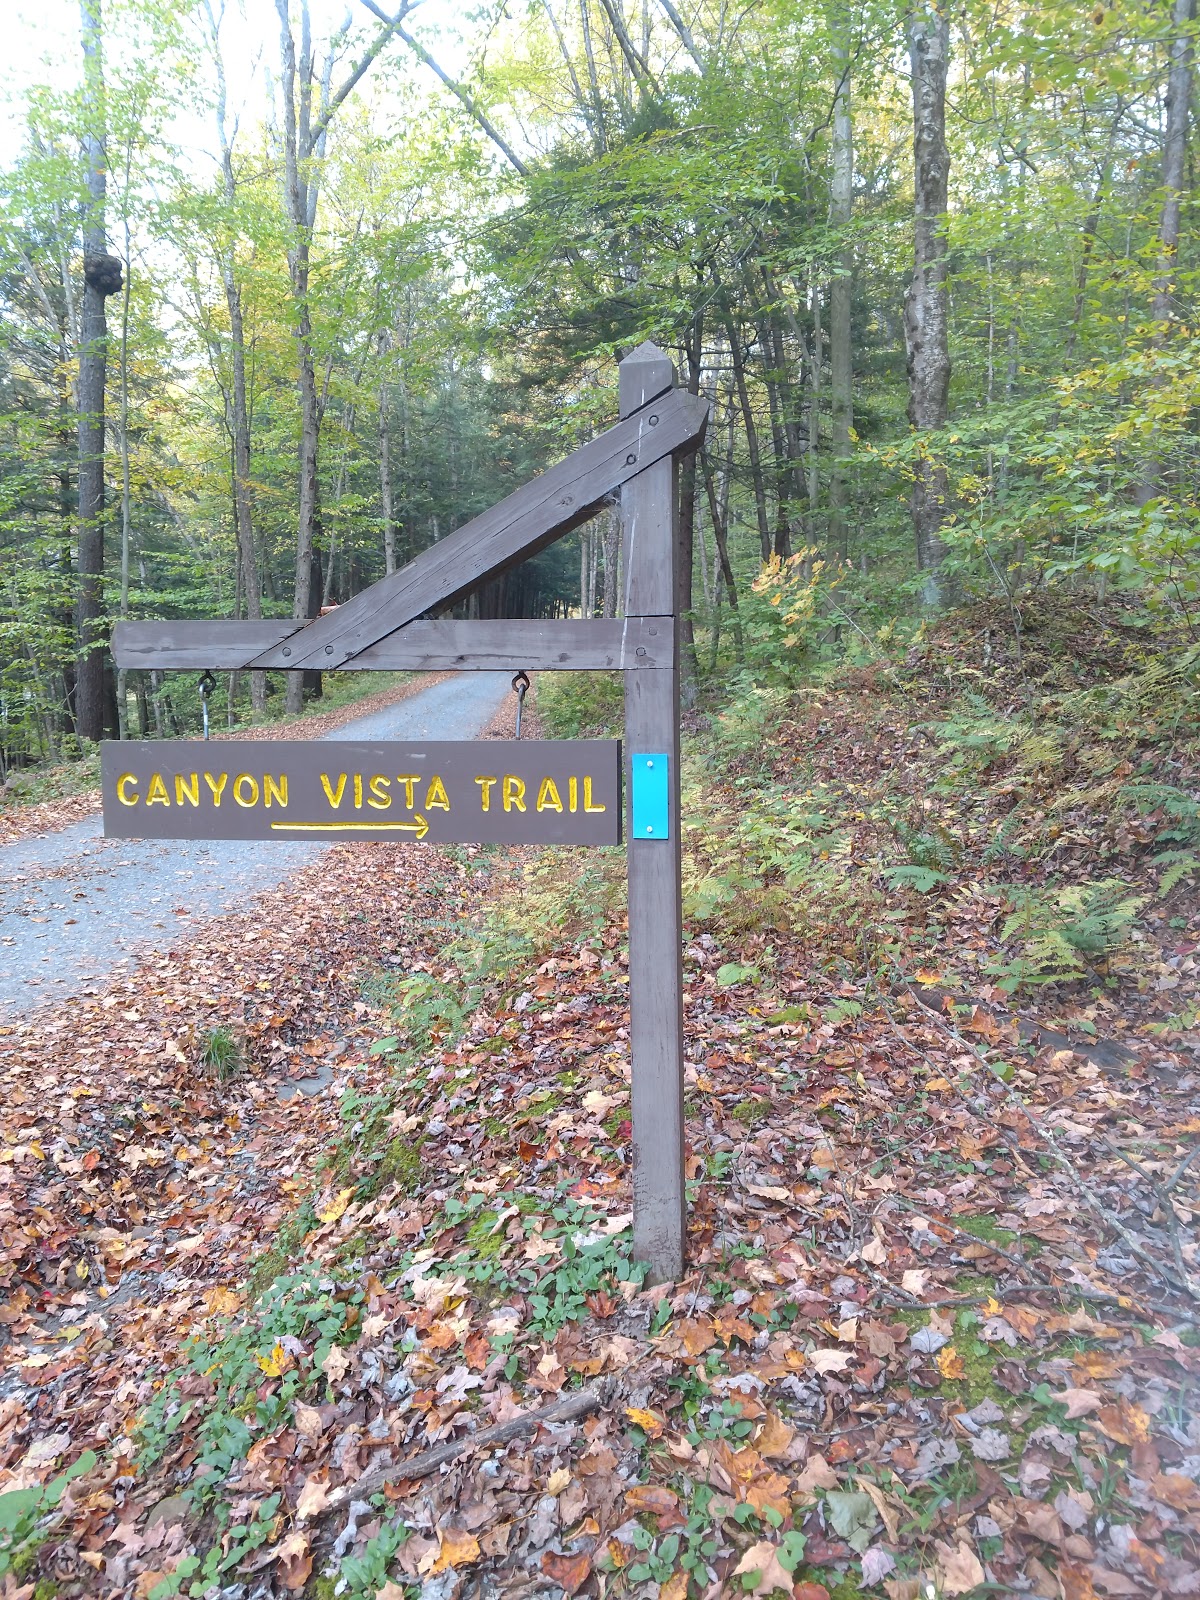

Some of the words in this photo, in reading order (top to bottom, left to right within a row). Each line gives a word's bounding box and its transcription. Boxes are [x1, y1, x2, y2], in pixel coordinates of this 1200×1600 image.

[115, 771, 289, 807] CANYON
[319, 772, 451, 811] VISTA
[473, 774, 607, 813] TRAIL
